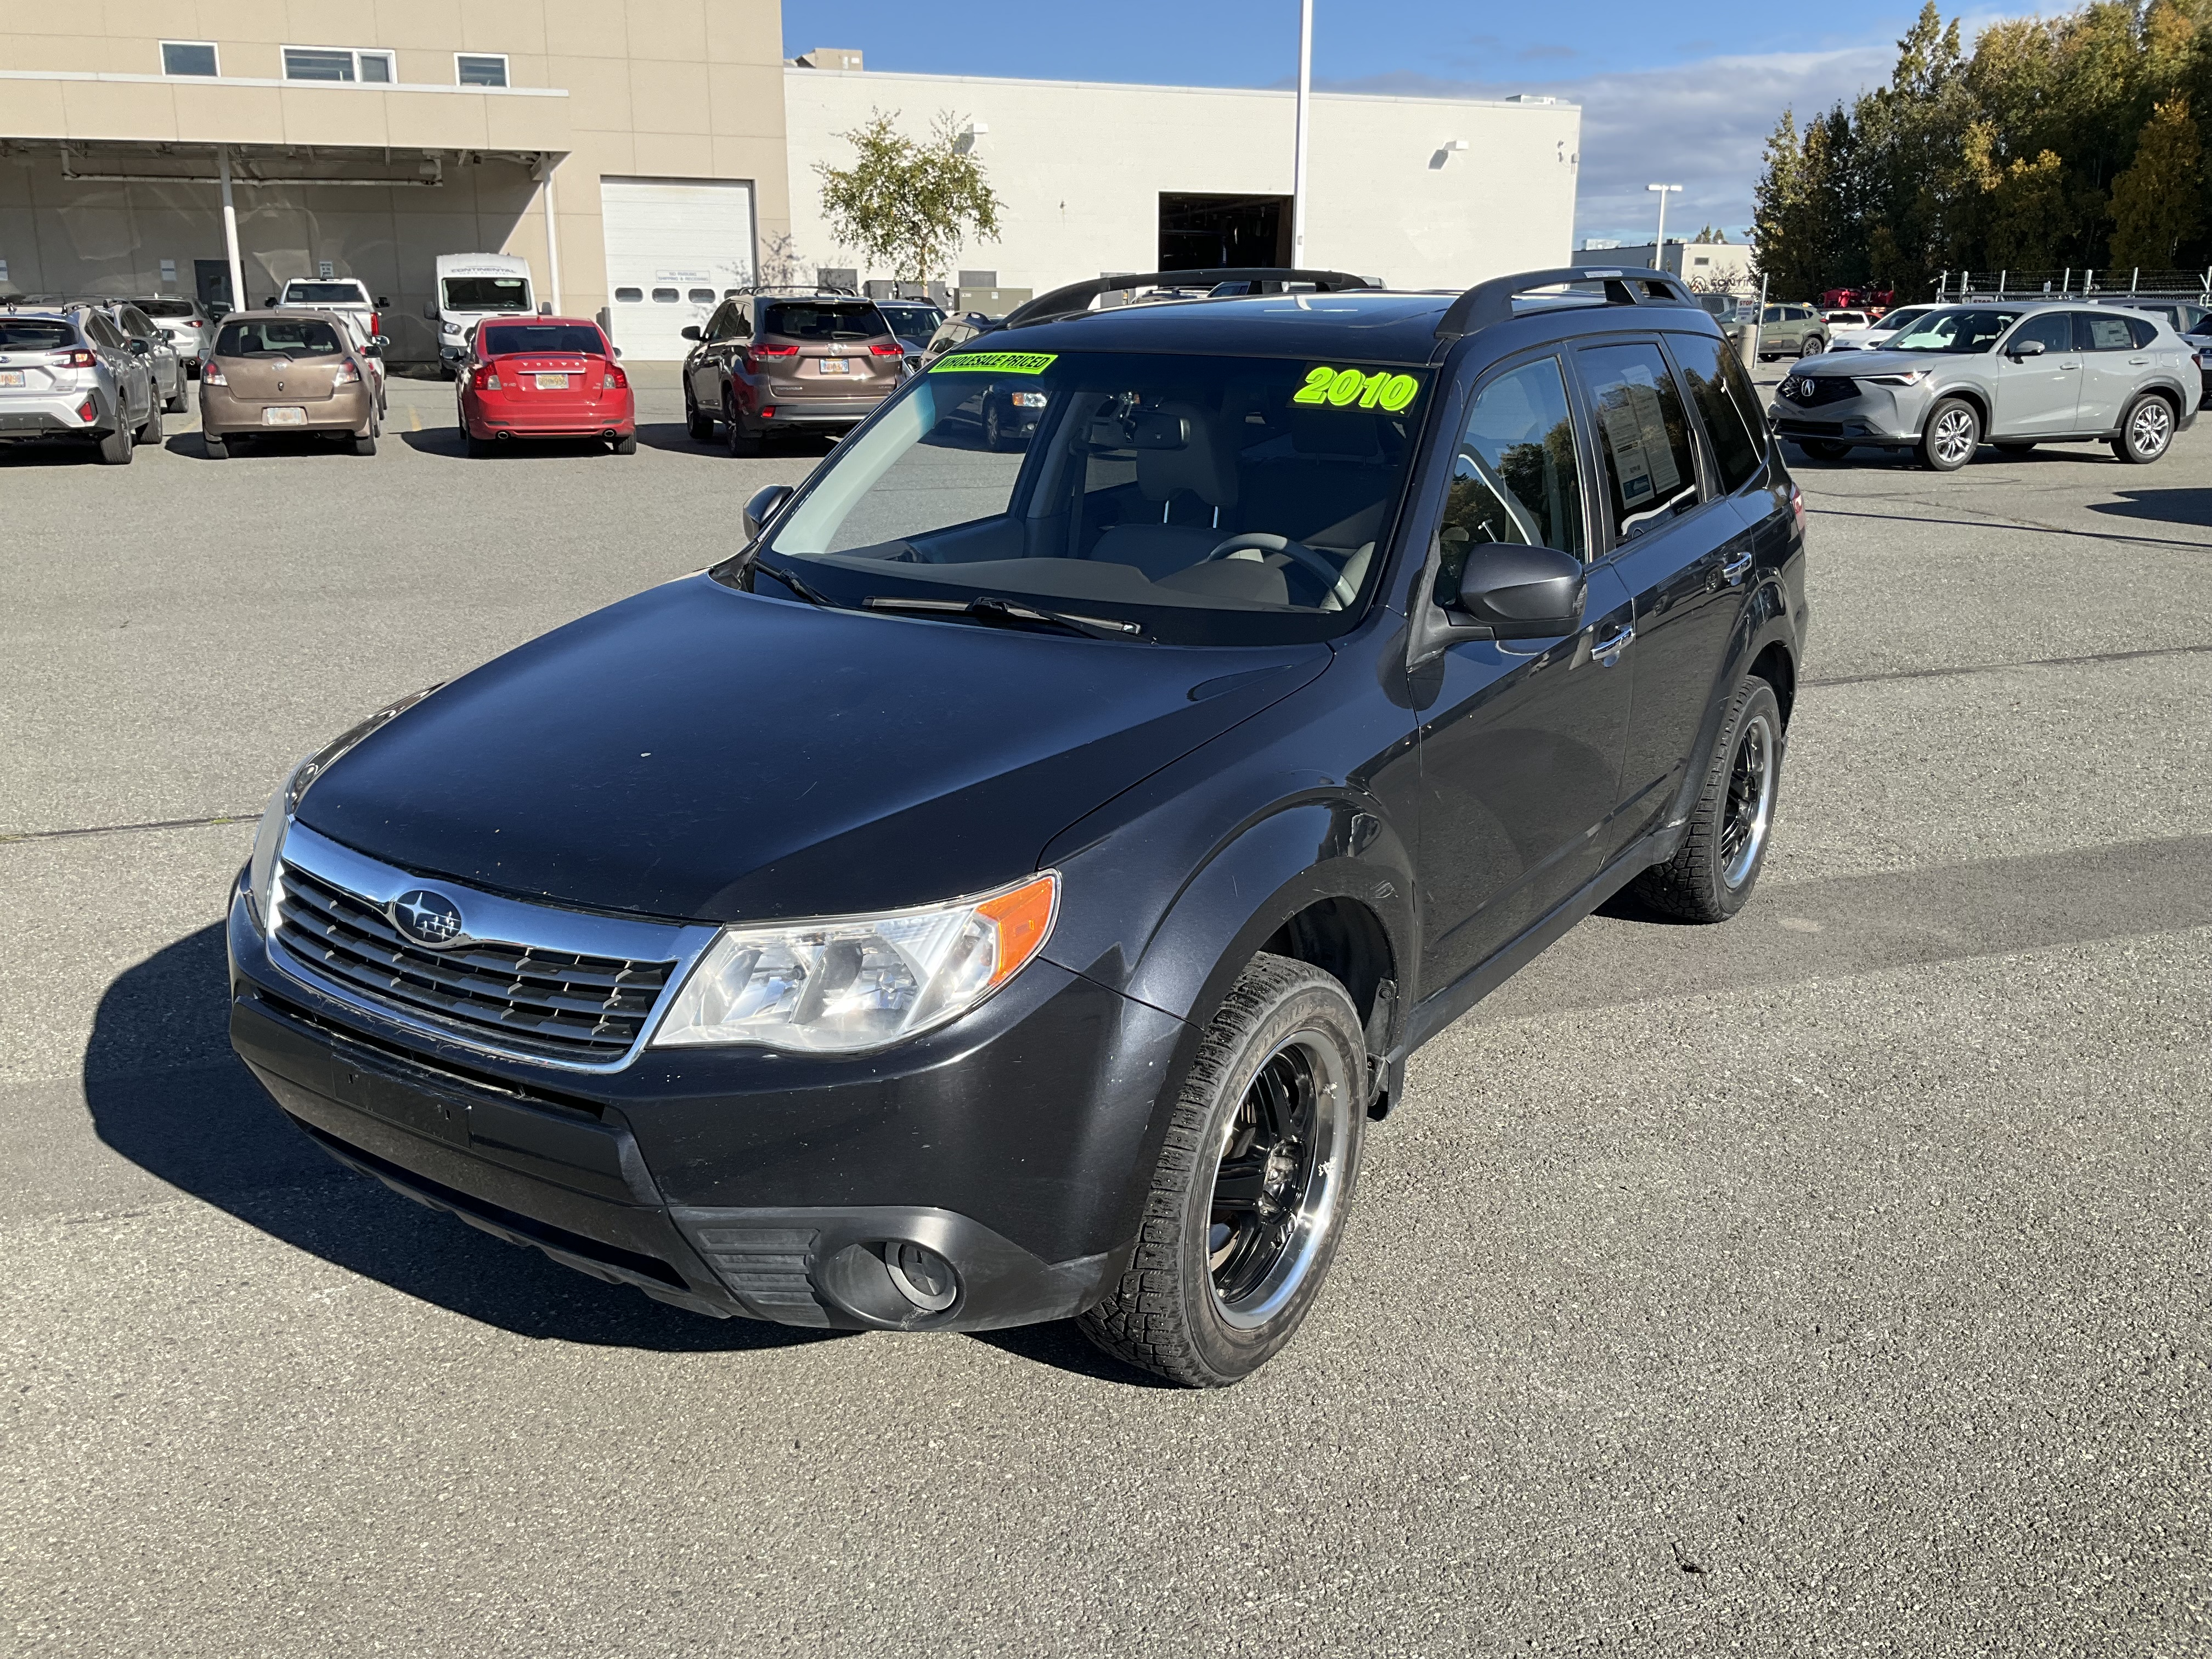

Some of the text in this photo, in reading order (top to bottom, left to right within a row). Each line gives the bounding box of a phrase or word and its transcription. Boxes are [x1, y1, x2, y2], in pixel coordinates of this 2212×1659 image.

[935, 355, 1052, 370] WHOLESALE PRICED
[1293, 366, 1418, 411] 2010
